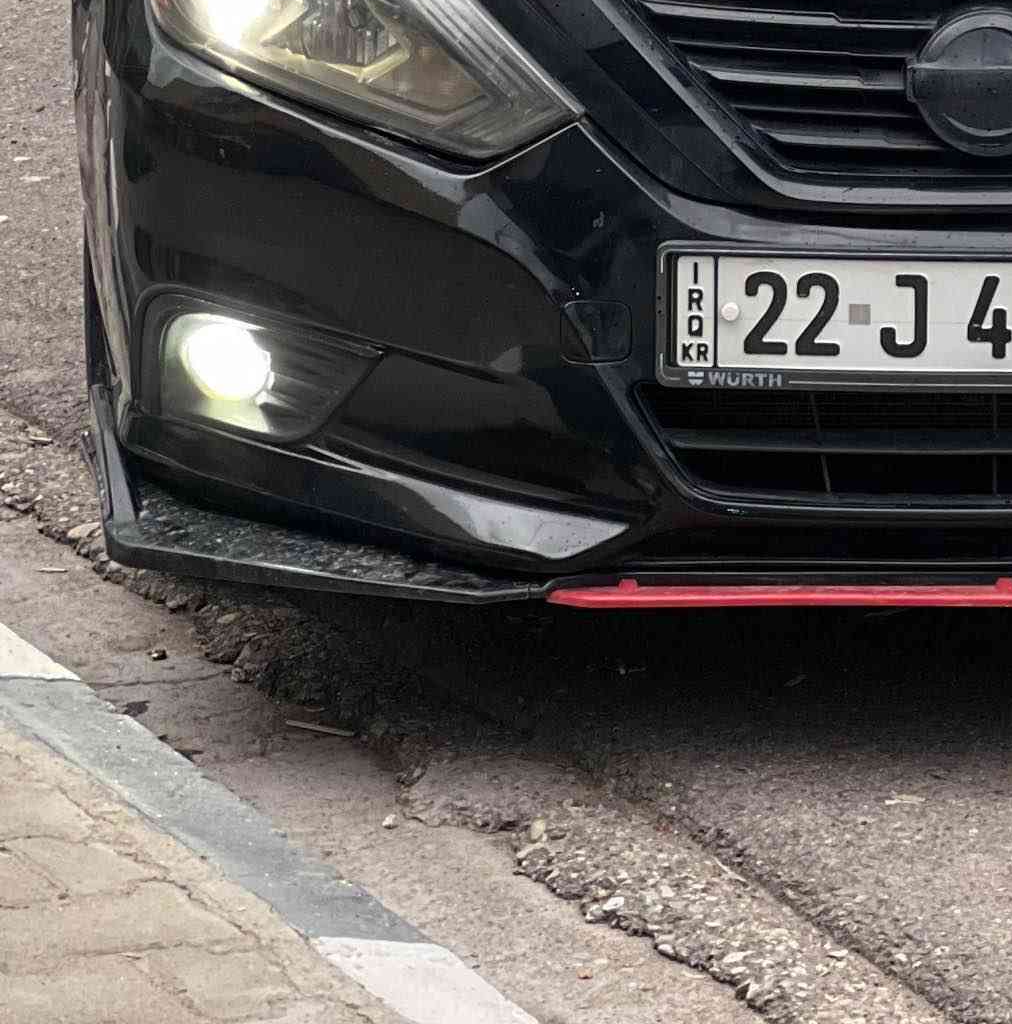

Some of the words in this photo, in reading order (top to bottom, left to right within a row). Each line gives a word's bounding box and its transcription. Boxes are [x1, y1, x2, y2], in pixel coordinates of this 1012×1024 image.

[743, 270, 842, 357] 22
[879, 273, 929, 359] J
[682, 342, 709, 362] KR
